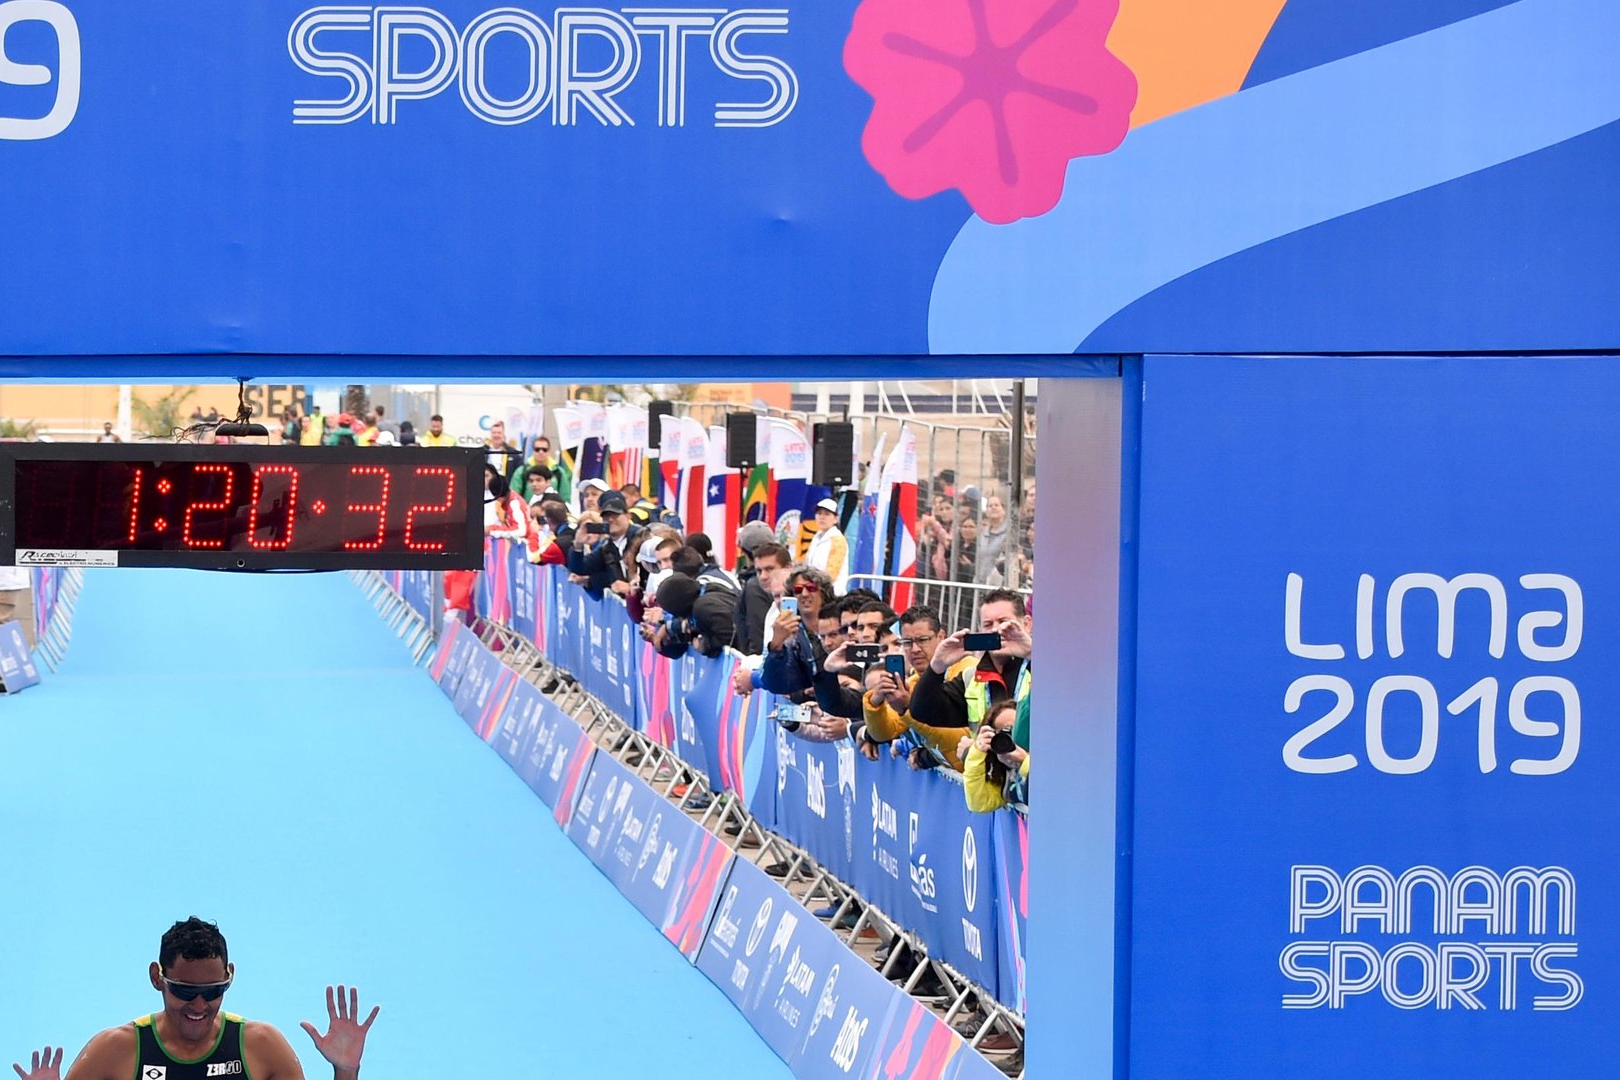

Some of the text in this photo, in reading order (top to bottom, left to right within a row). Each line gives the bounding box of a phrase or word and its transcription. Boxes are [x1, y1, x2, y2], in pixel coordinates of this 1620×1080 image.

[287, 6, 799, 128] SPORTS
[1282, 674, 1582, 776] 2019
[1289, 865, 1577, 935] PANAM
[1280, 941, 1584, 1011] SPORTS
[830, 1005, 869, 1073] Atos
